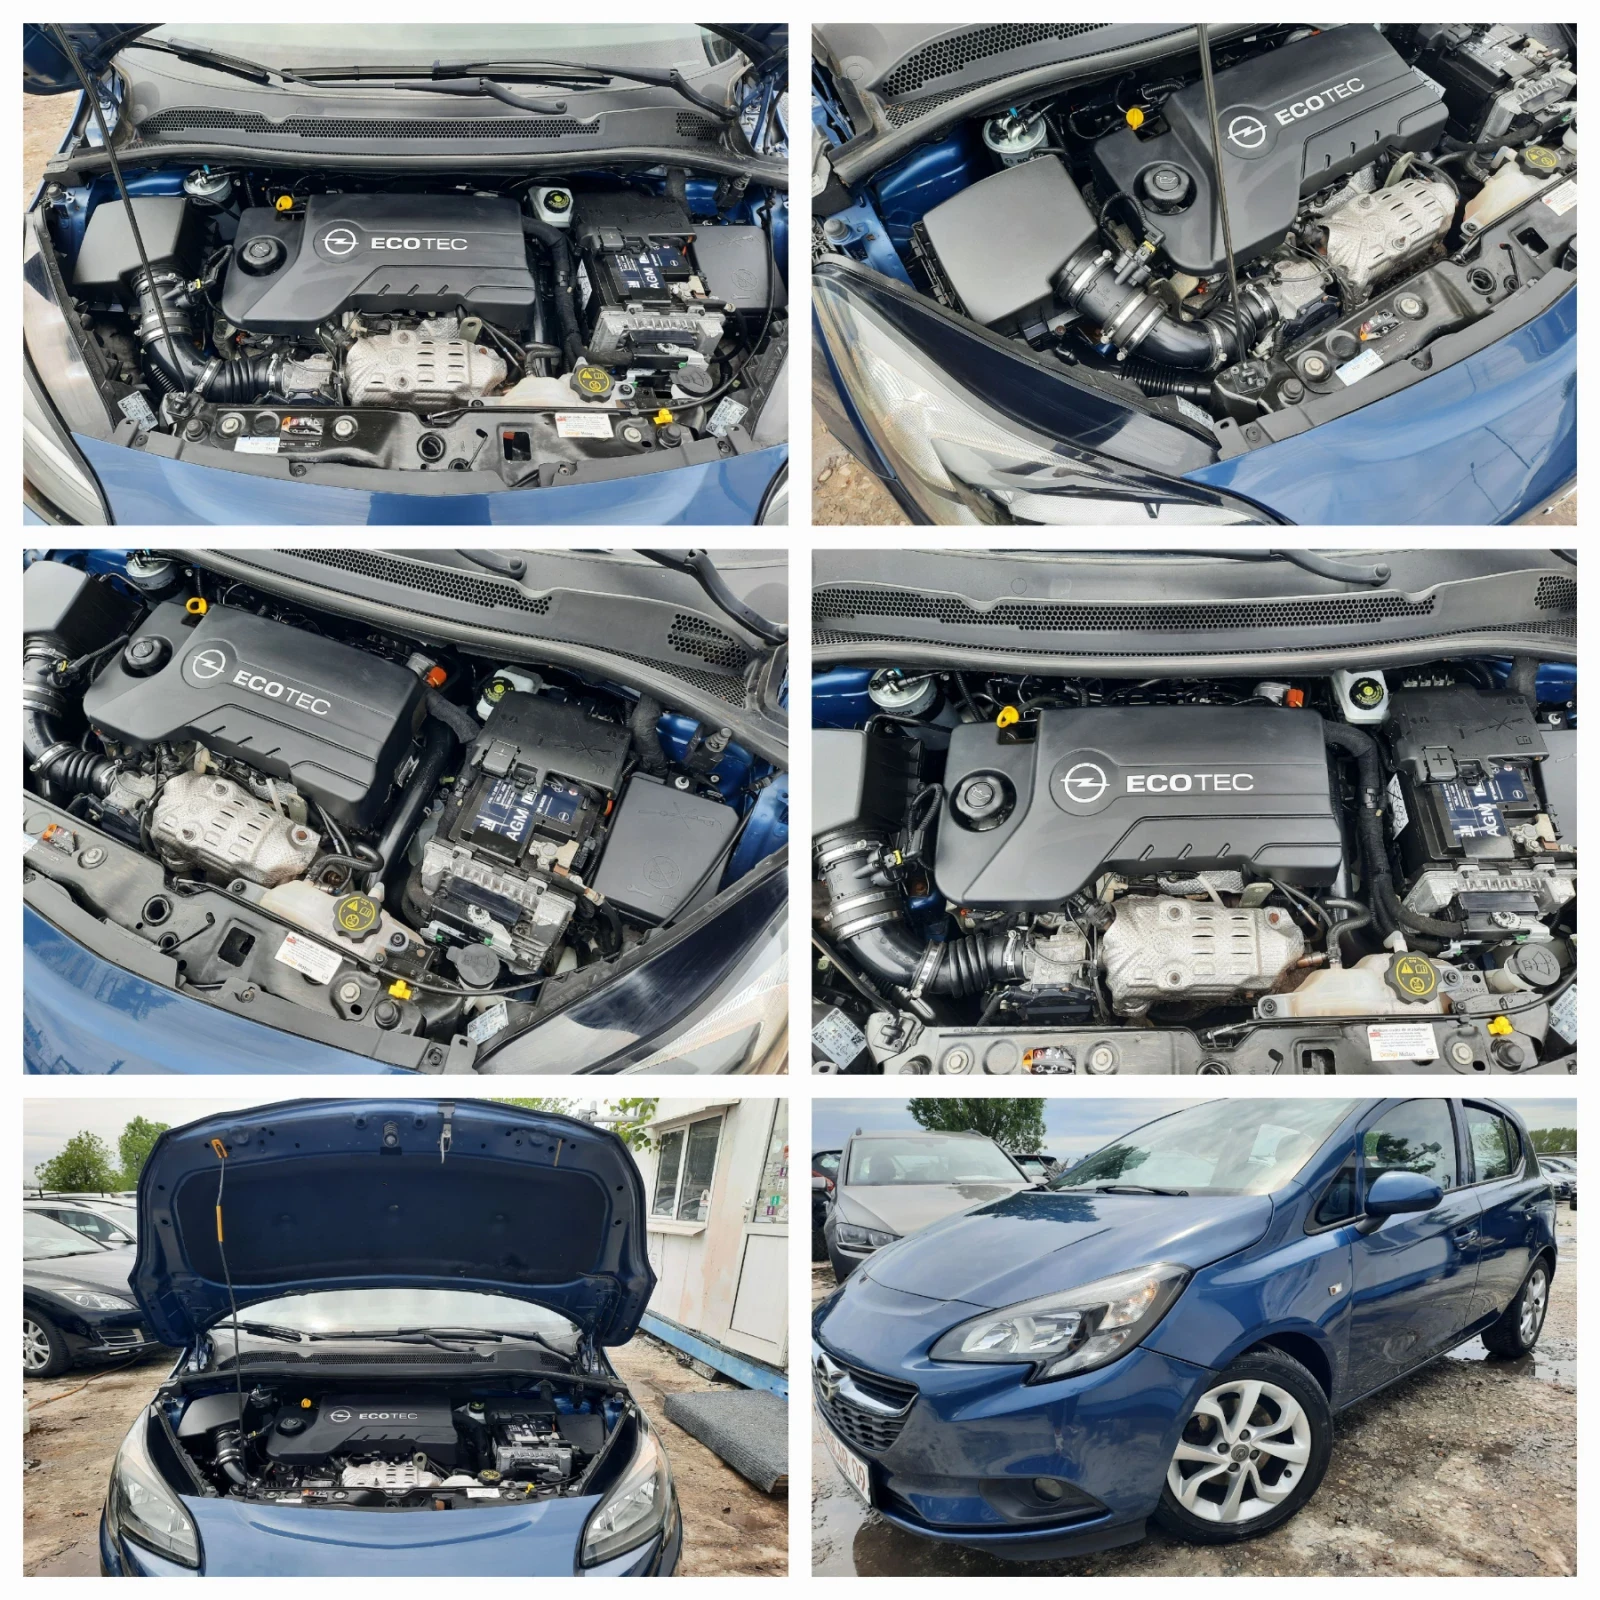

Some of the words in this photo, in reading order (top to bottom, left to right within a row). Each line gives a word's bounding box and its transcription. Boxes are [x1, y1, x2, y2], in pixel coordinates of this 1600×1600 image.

[1274, 78, 1365, 126] ECOTEC
[371, 237, 468, 251] ECOTEC
[643, 267, 660, 289] AGM
[232, 669, 331, 715] ECOTEC
[1126, 773, 1254, 792] ECOTEC
[507, 808, 529, 841] AGM
[1478, 803, 1501, 837] AGM
[812, 1031, 826, 1044] A25
[359, 1412, 418, 1420] ECOTEC
